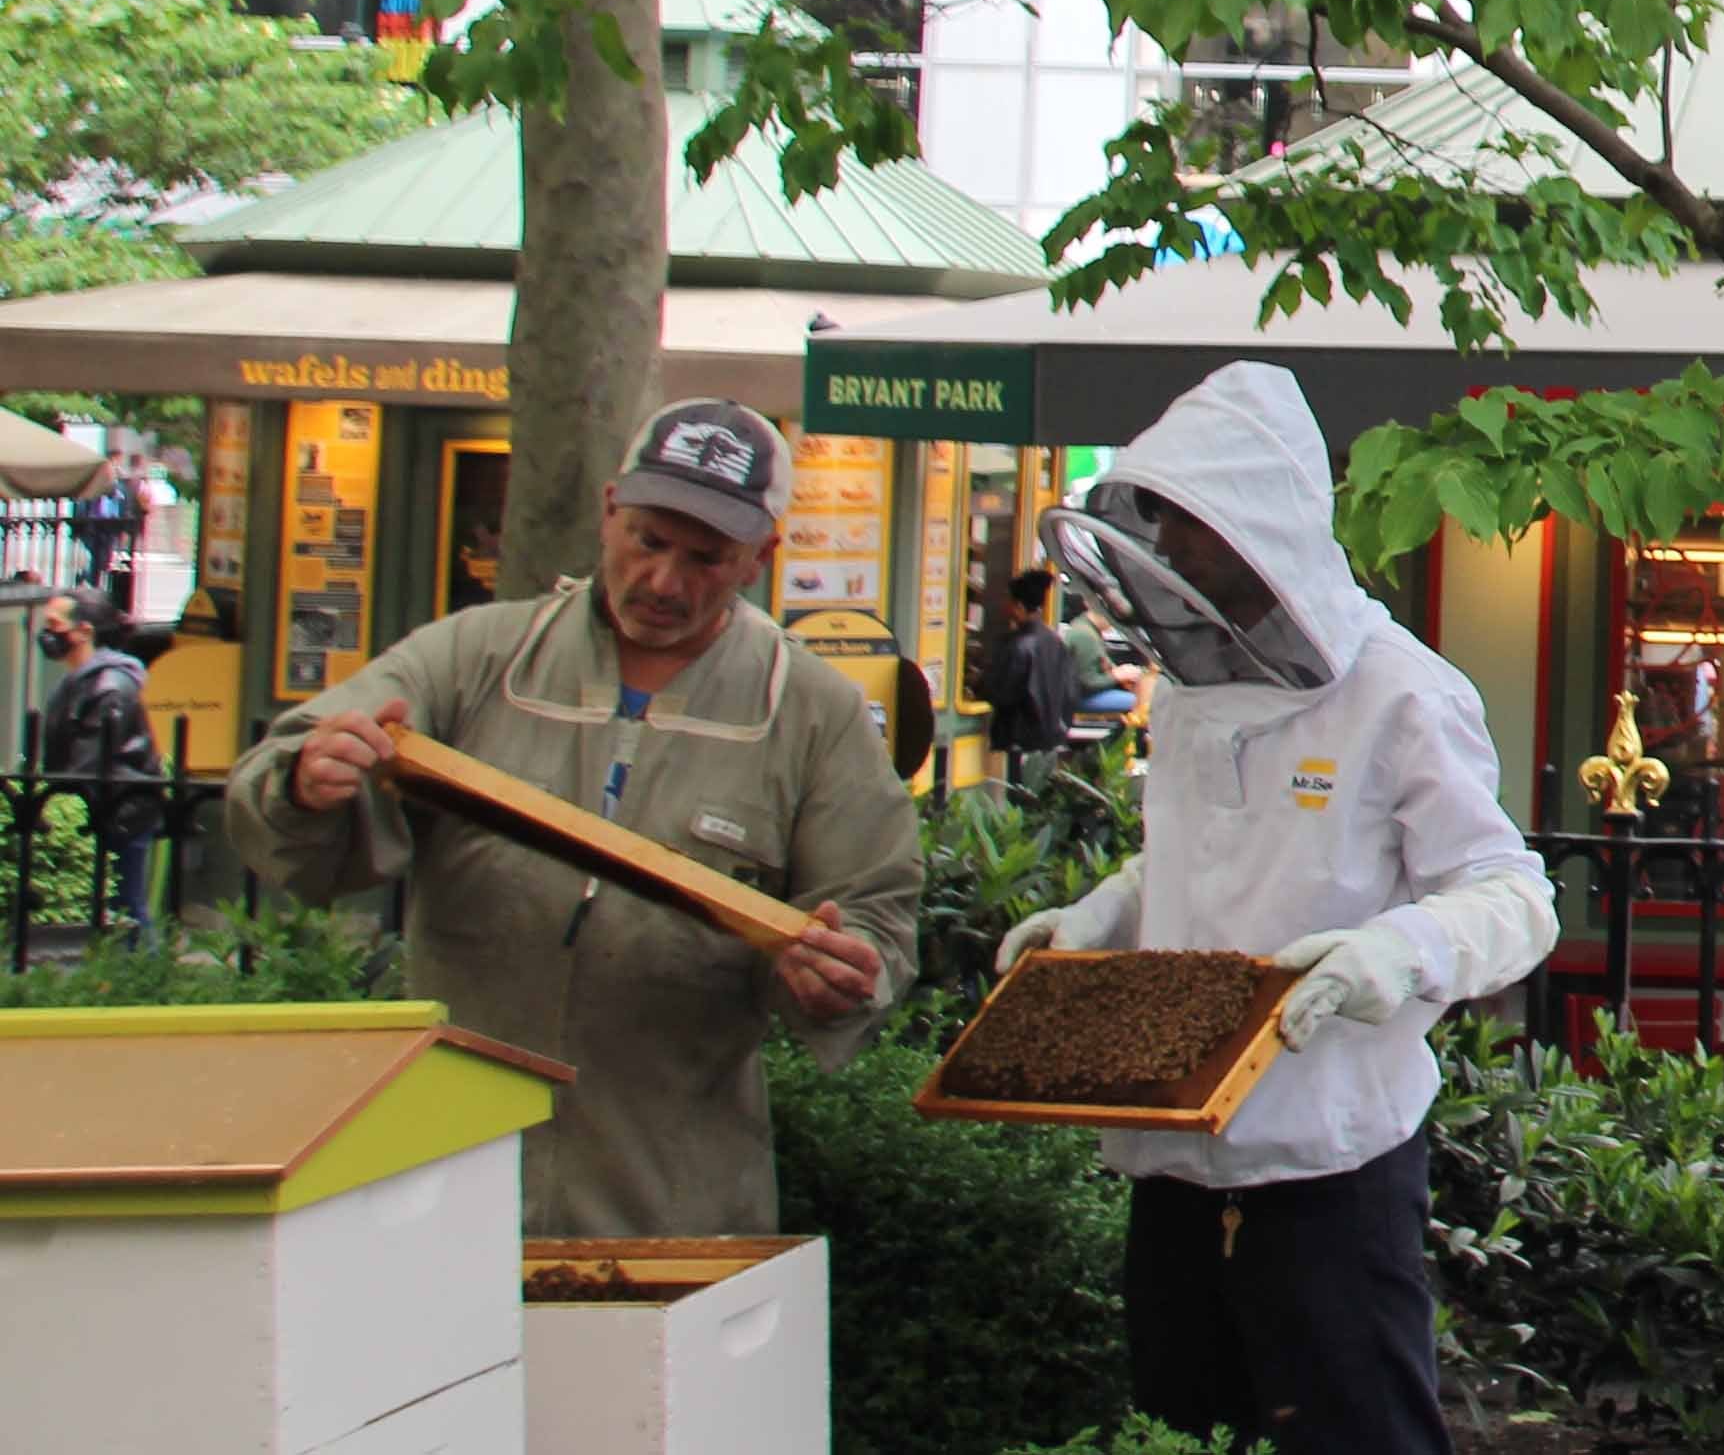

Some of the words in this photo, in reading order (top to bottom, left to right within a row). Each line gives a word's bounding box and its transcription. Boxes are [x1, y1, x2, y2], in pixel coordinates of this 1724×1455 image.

[240, 353, 370, 389] wafels
[374, 358, 418, 391] and
[828, 374, 927, 409] BRYANT
[935, 378, 1004, 412] PARK
